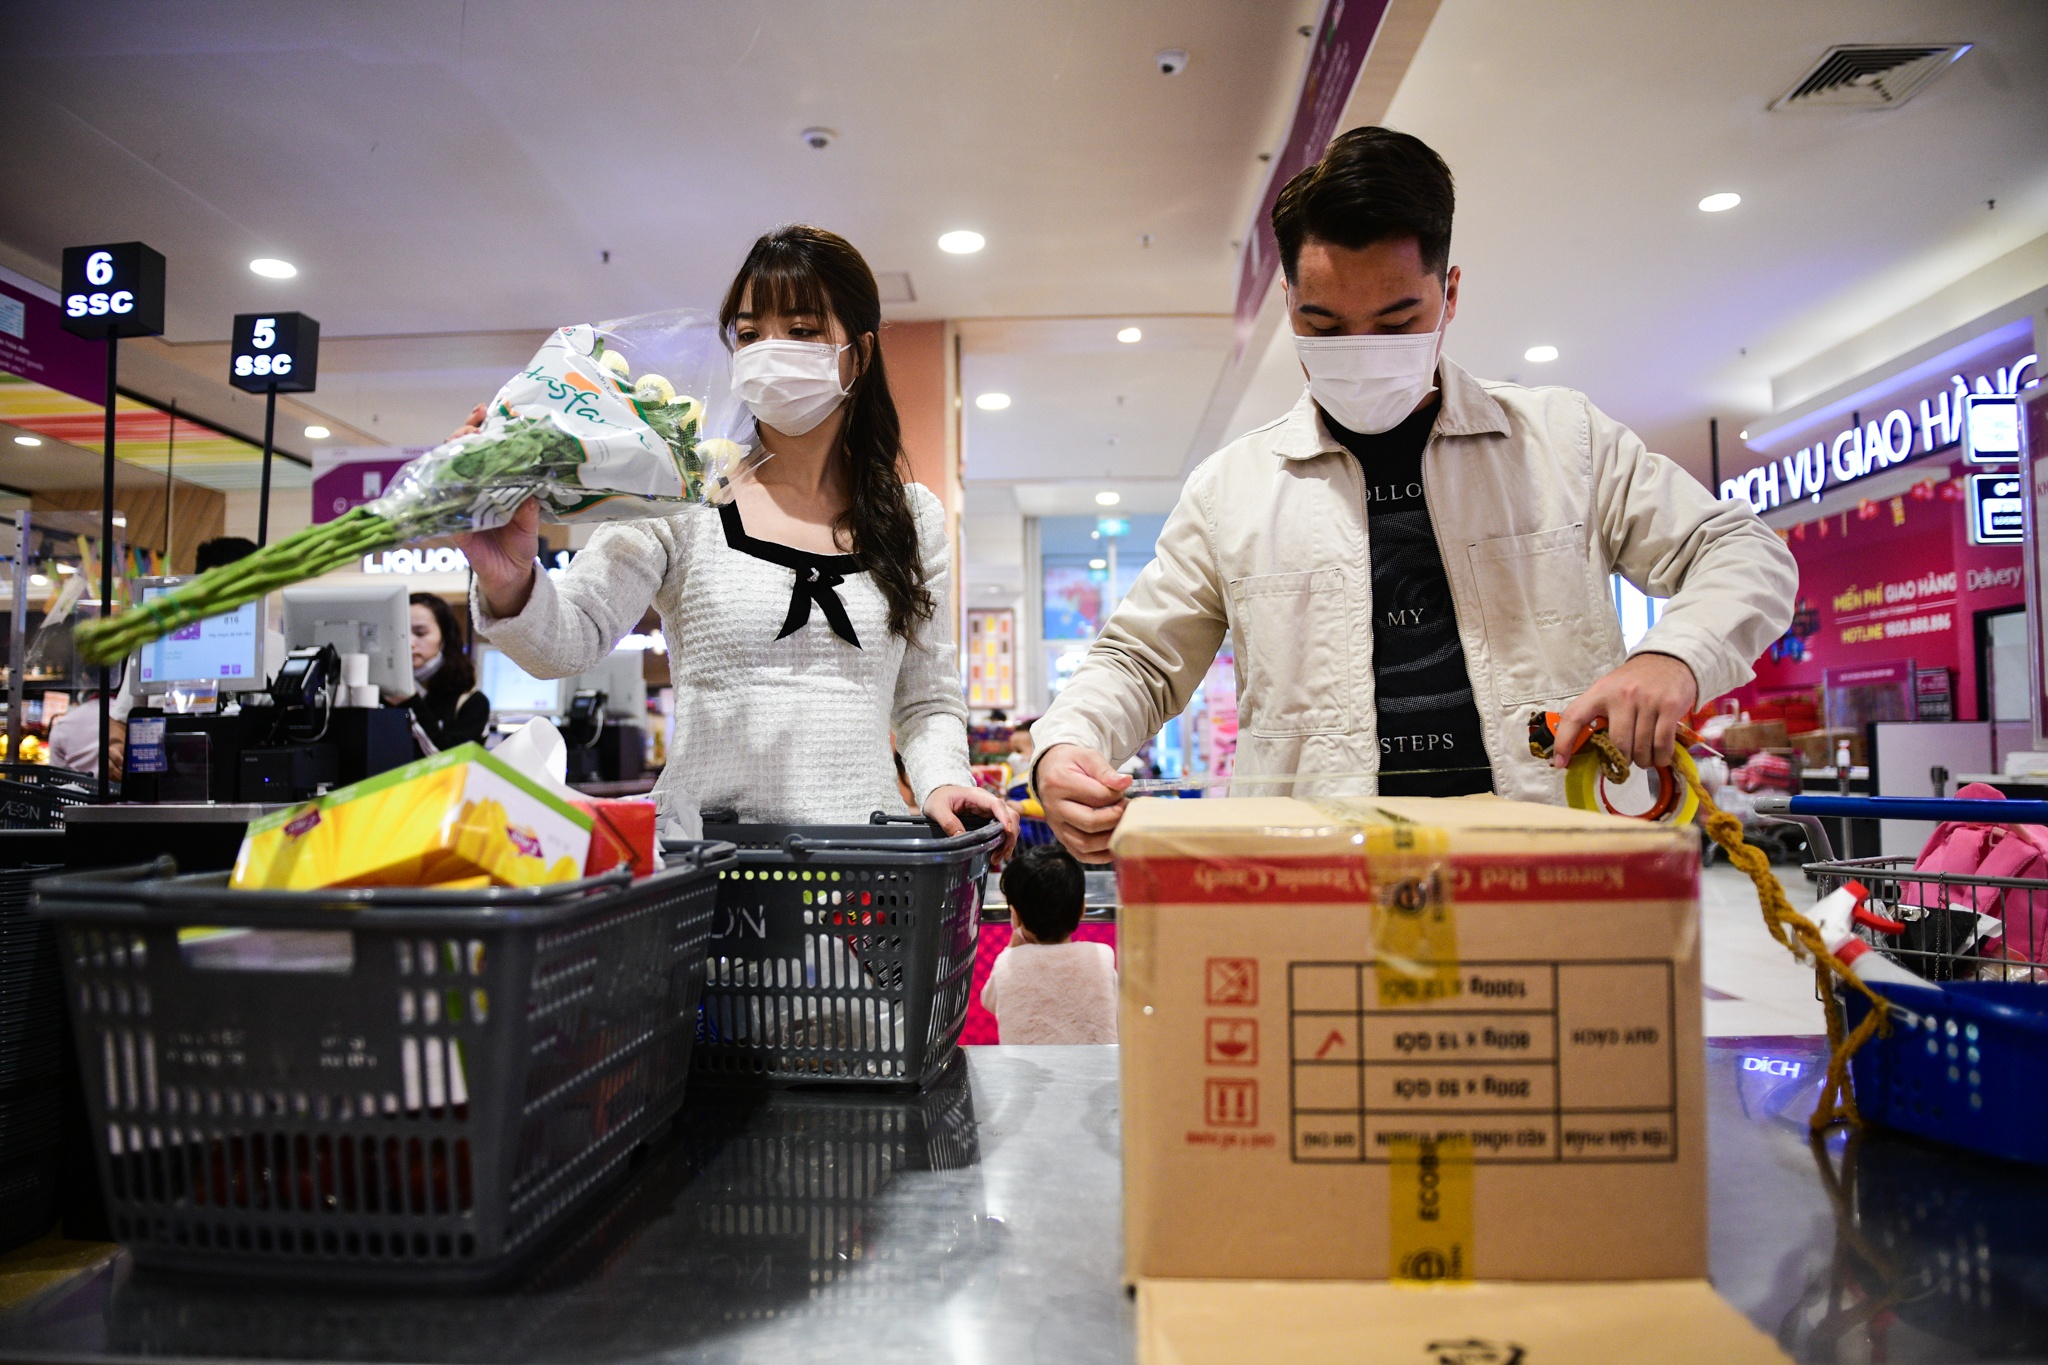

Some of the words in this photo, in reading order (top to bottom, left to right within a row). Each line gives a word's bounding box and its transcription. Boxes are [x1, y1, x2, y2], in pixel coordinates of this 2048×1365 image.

[86, 251, 114, 286] 6
[66, 290, 134, 318] SSC
[252, 317, 276, 349] 5
[234, 353, 292, 377] SSC
[1783, 441, 1826, 504] VỤ
[1831, 409, 1913, 481] GIAO
[1365, 481, 1422, 502] OLLO
[1884, 580, 1917, 604] GIAO
[1917, 571, 1957, 598] HÀNG
[1966, 565, 2023, 592] Delivery
[1387, 607, 1424, 628] MY
[1841, 622, 1884, 644] HOTLINE
[1380, 732, 1455, 754] STEPS
